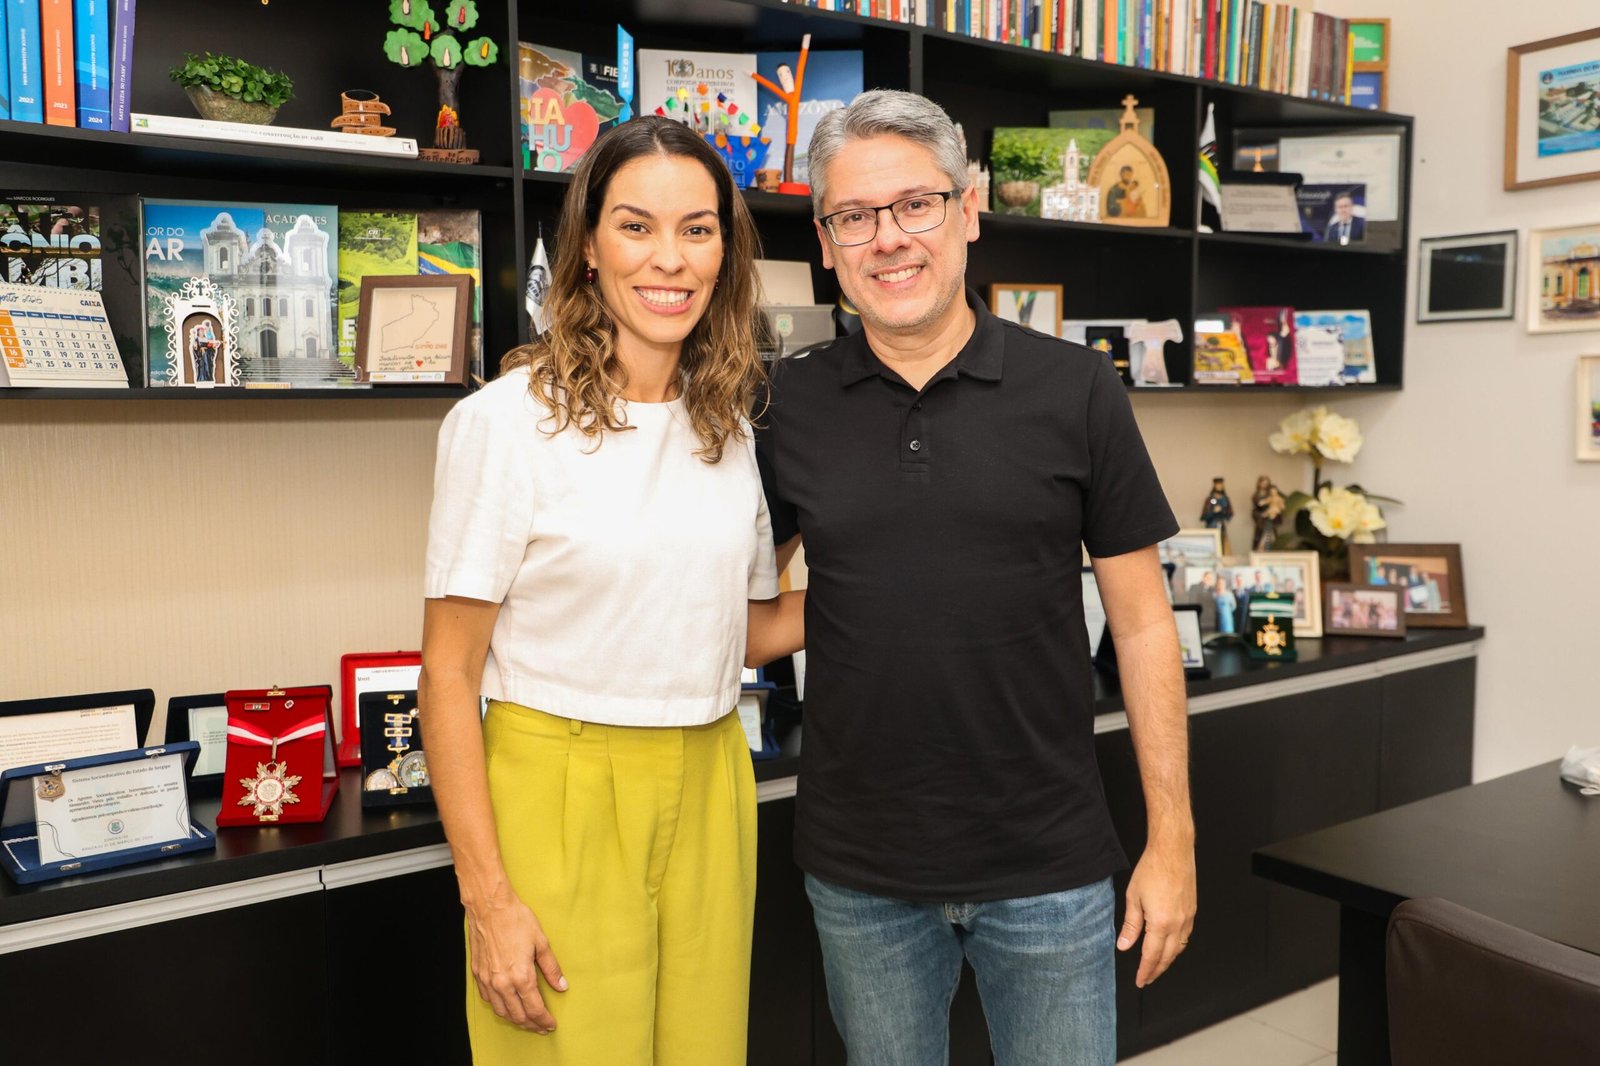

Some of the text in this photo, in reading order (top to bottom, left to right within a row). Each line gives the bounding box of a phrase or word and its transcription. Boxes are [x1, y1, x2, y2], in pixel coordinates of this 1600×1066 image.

[697, 68, 734, 80] anos
[167, 227, 184, 236] DO
[0, 257, 102, 289] MBI
[91, 772, 125, 780] Socioeducativo
